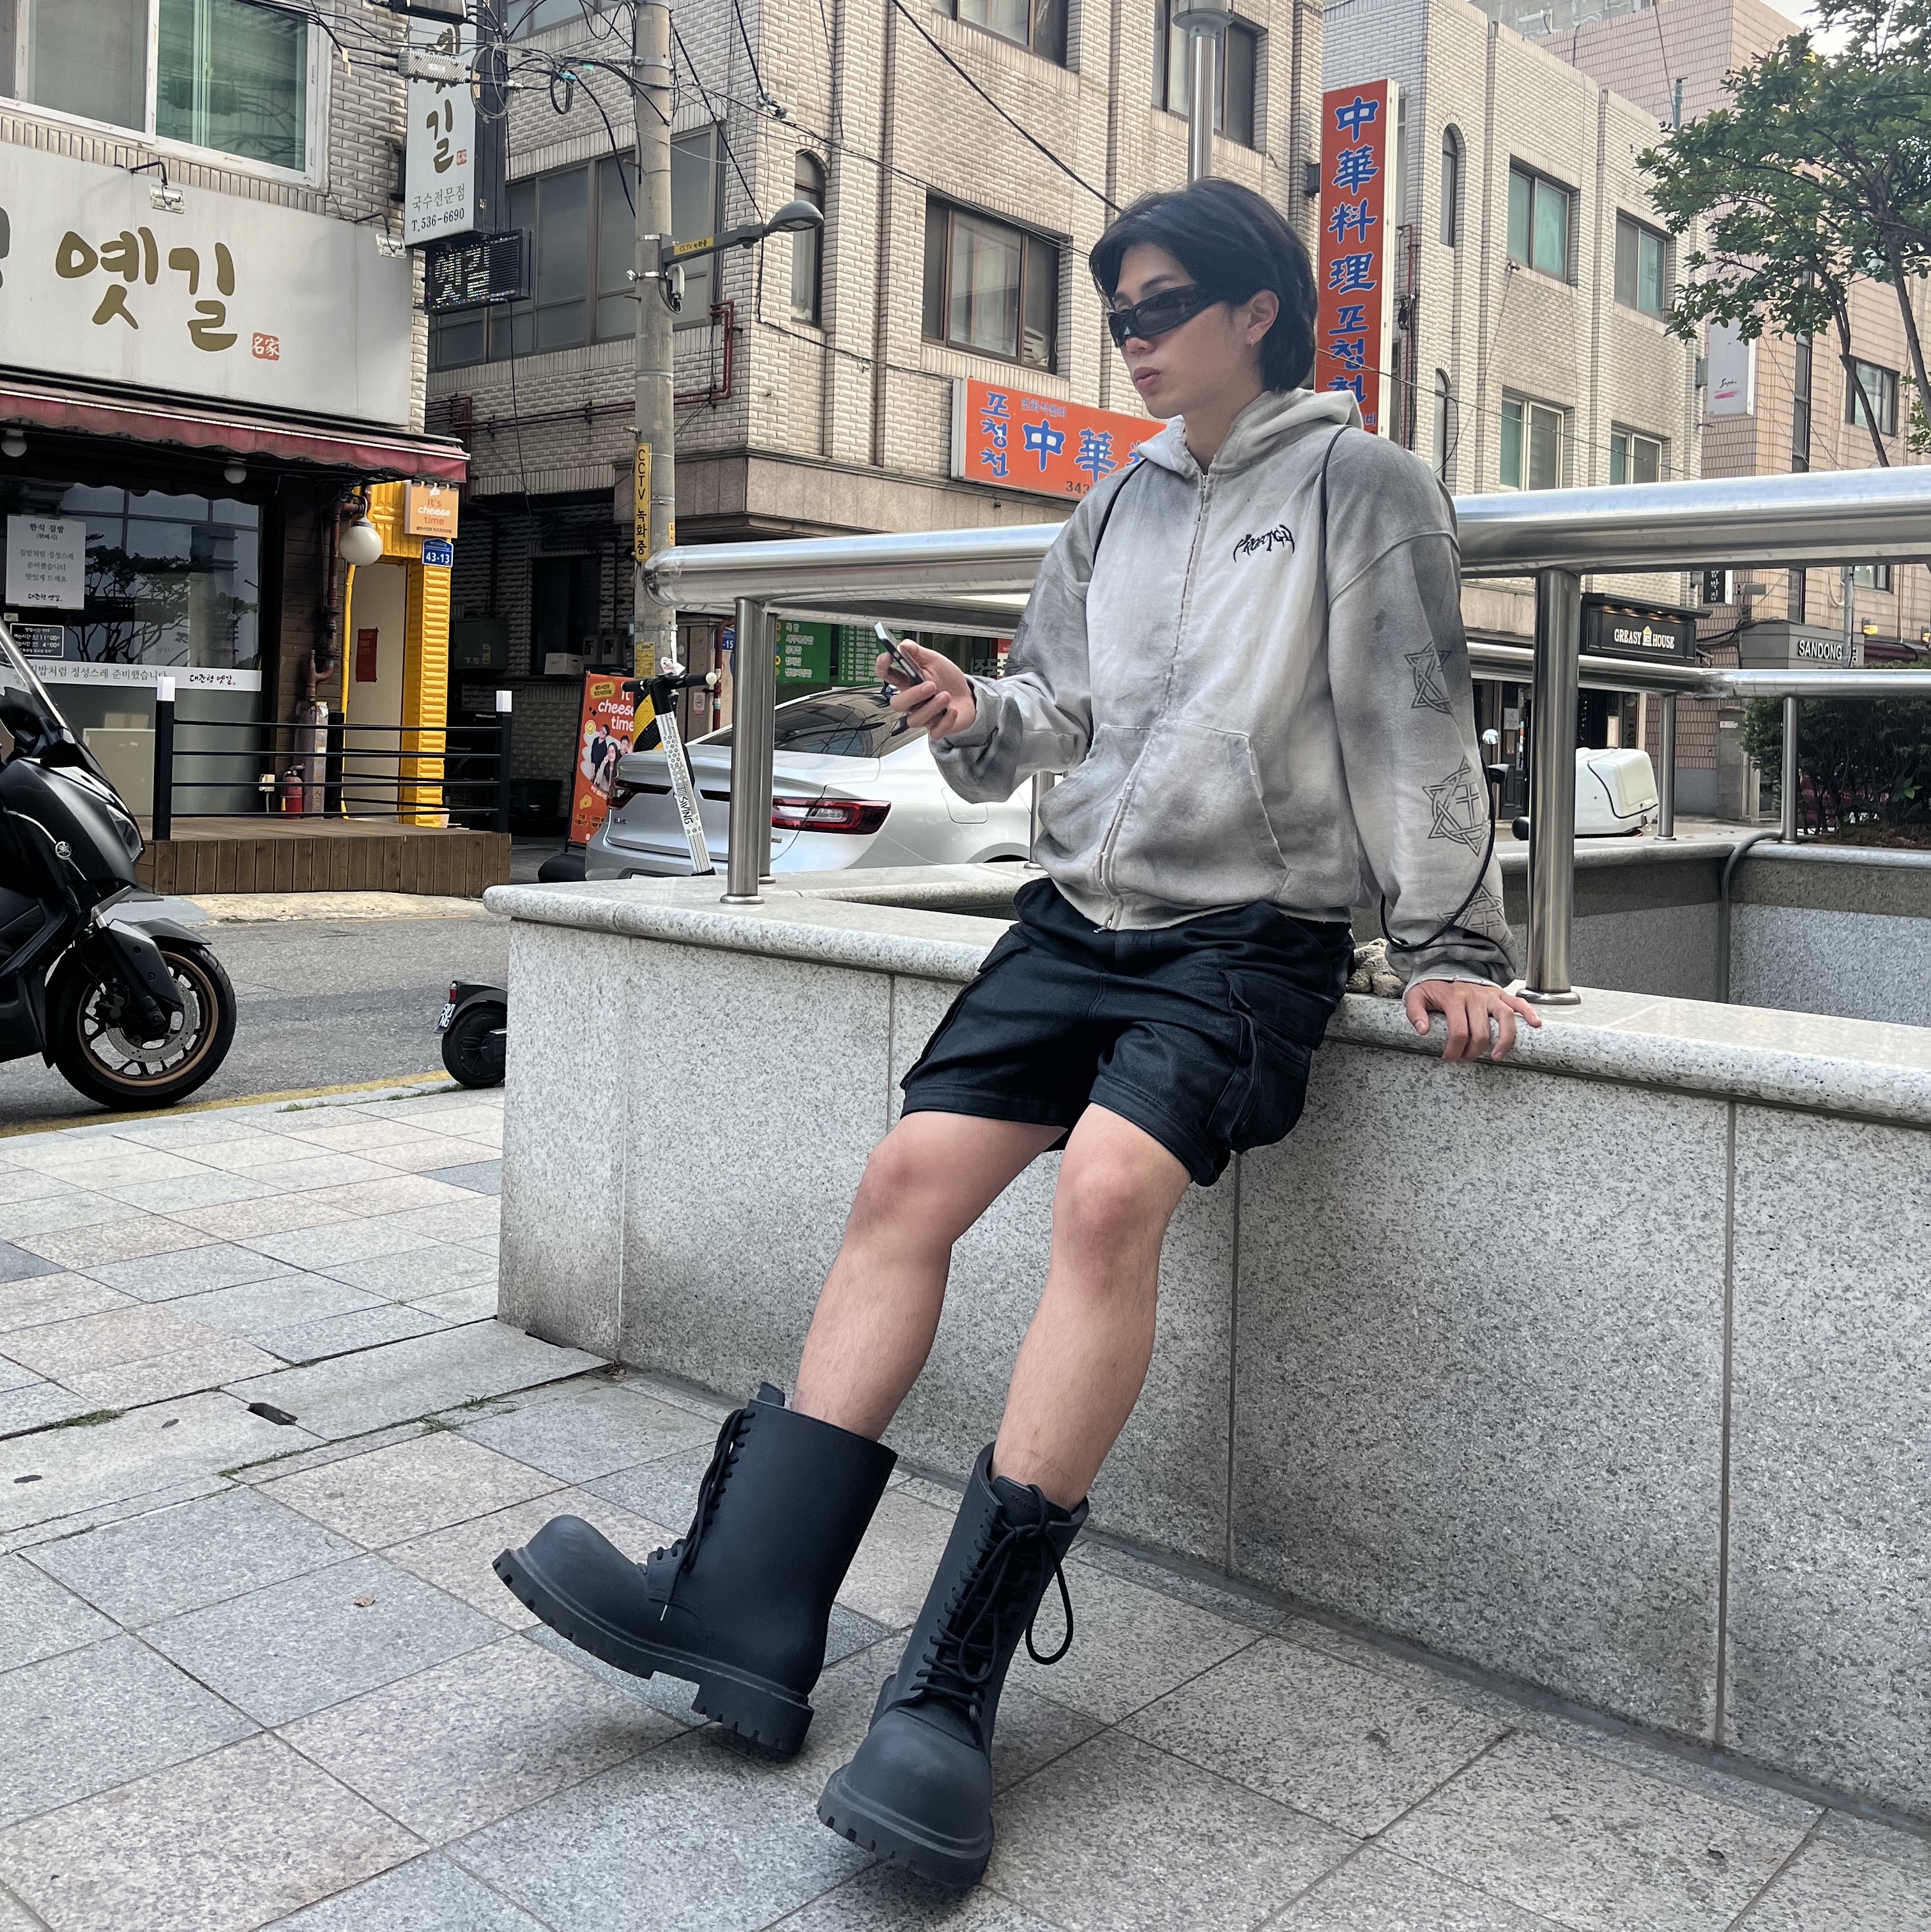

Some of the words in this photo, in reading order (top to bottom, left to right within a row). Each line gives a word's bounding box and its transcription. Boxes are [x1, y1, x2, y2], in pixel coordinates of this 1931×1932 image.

[411, 183, 466, 212] 국수전문점
[1328, 96, 1379, 294] 中華料理
[411, 208, 465, 232] T.536-6690
[679, 243, 693, 252] CCTV
[434, 247, 491, 303] 옛길
[56, 227, 238, 351] 옛길
[1327, 303, 1369, 404] 포청천
[980, 391, 1011, 478] 포청천
[637, 448, 646, 501] CCTV
[417, 505, 452, 517] cheese
[427, 498, 442, 508] It's
[29, 522, 45, 532] 한식
[424, 515, 445, 526] time
[636, 508, 648, 556] 녹화중
[425, 551, 450, 564] 43-13
[1614, 628, 1642, 646] GREASY
[1652, 634, 1675, 650] HOUSE
[1798, 639, 1843, 660] SANDONG
[71, 667, 109, 679] 정성스레
[189, 674, 214, 683] 대관령
[217, 674, 233, 685] 옛길
[611, 715, 634, 732] time
[678, 796, 694, 825] SIVING
